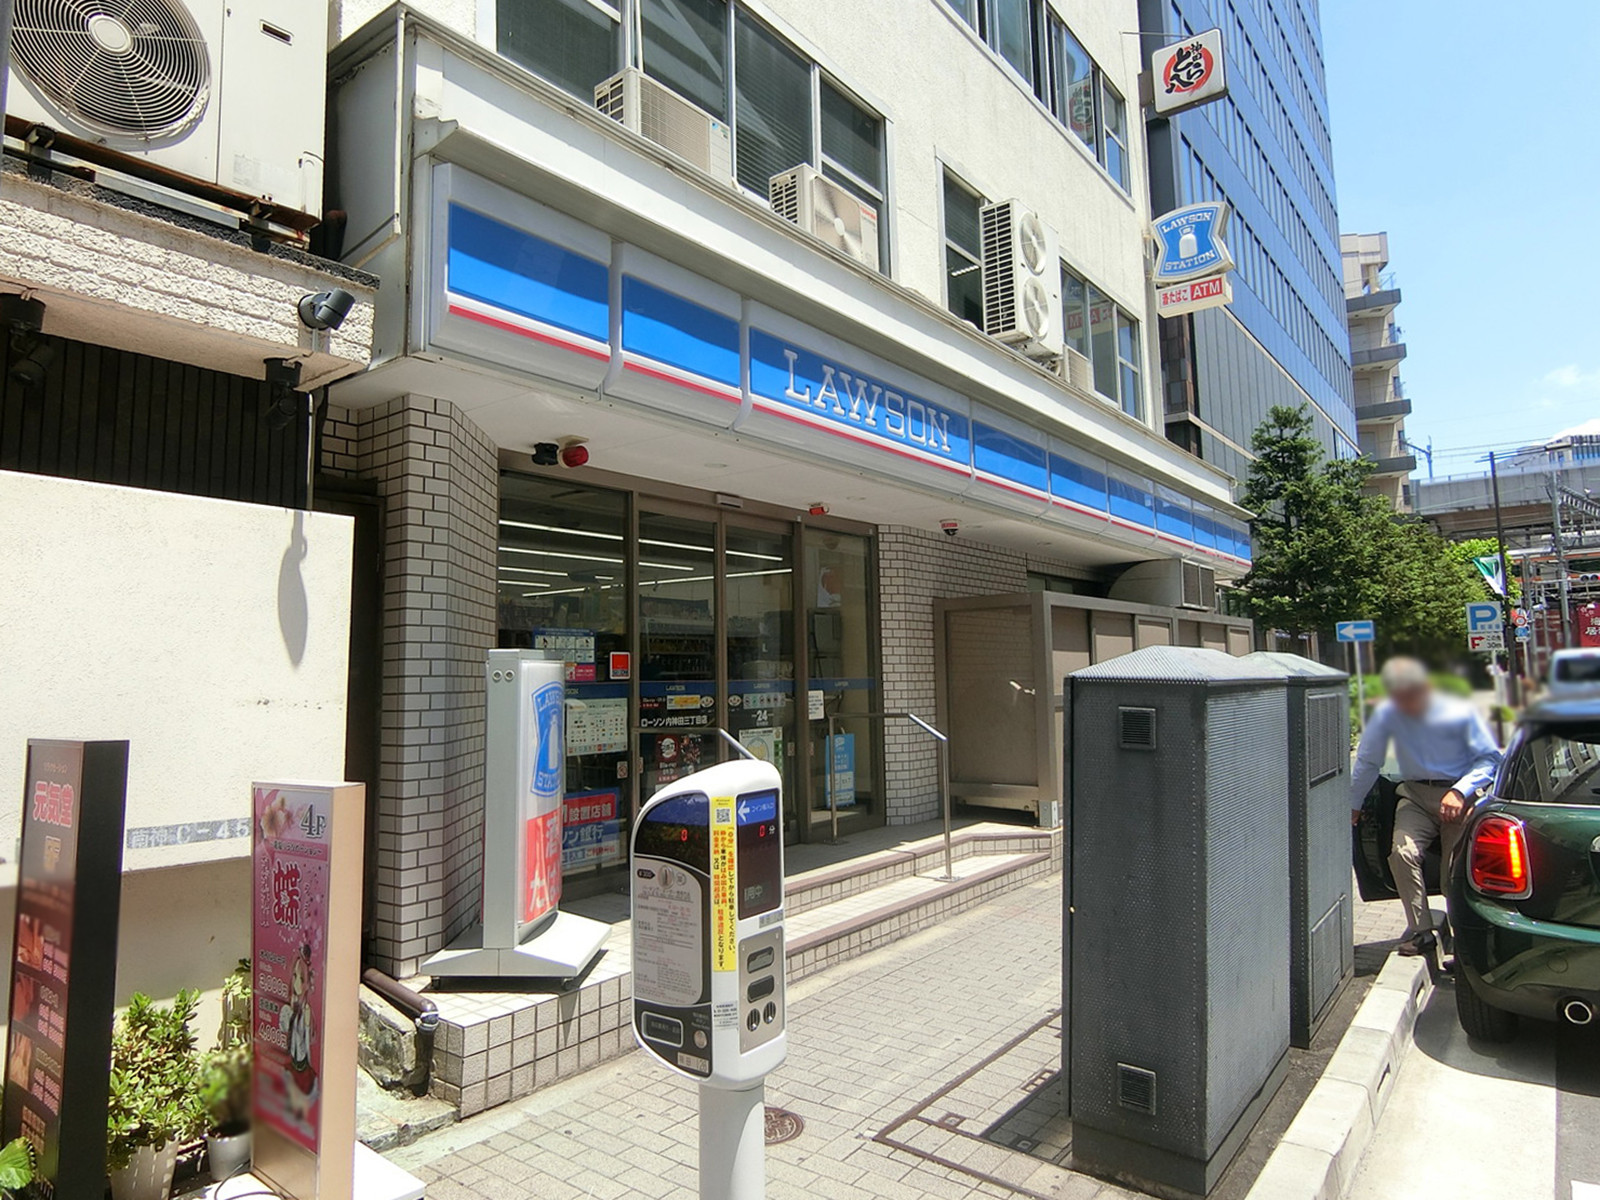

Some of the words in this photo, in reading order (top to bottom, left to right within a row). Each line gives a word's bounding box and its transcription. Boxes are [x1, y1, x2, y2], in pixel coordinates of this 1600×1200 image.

[1162, 212, 1212, 233] LAWSON
[1165, 250, 1215, 271] STATION
[1162, 289, 1188, 305] 酒たばこ
[1193, 280, 1220, 299] ATM
[784, 349, 952, 453] LAWSON
[1470, 604, 1497, 631] P
[641, 715, 708, 728] ローソン内神田三丁目店
[33, 781, 74, 828] 元気堂
[301, 804, 326, 836] 4F
[681, 829, 688, 841] 0
